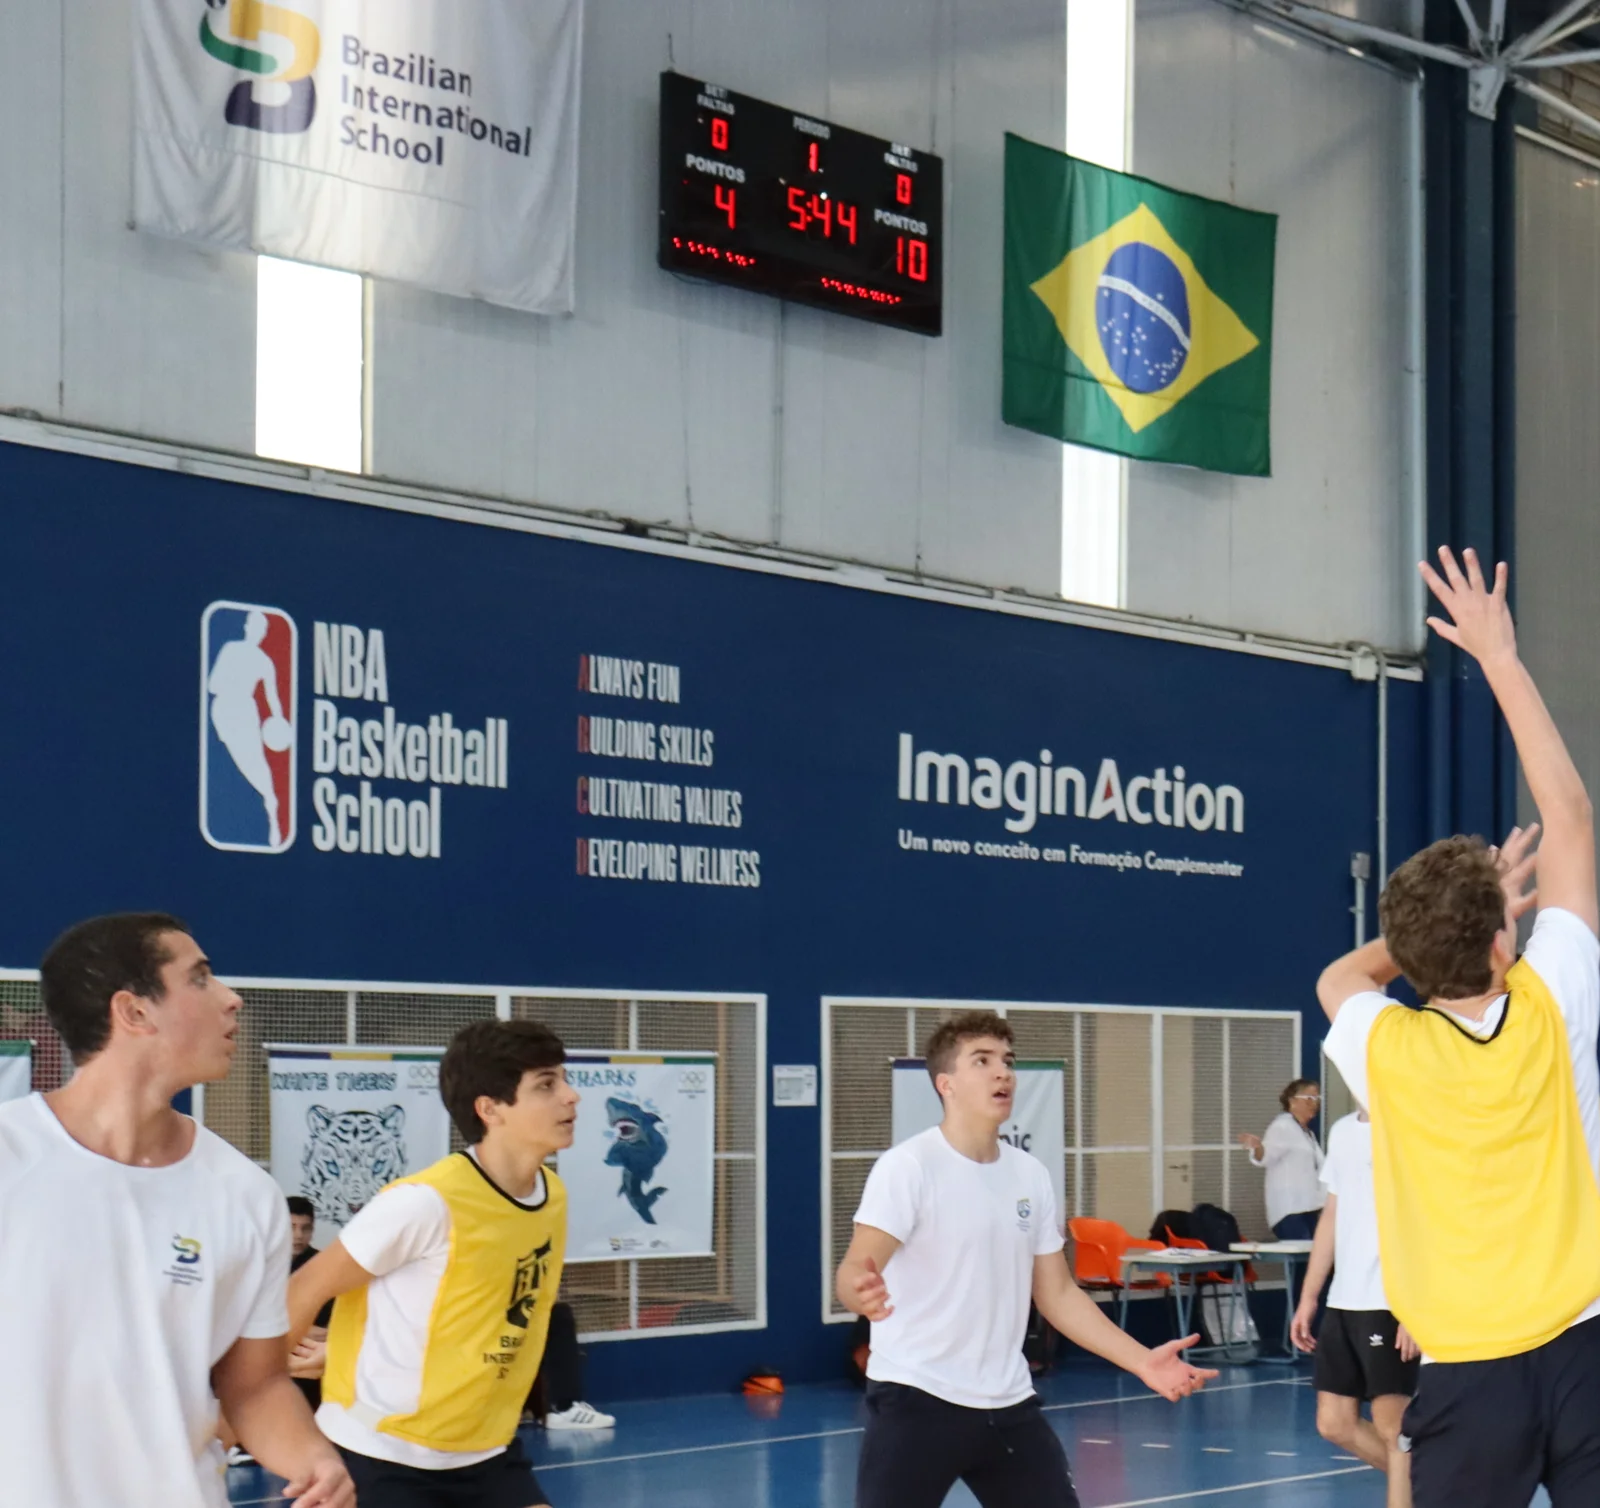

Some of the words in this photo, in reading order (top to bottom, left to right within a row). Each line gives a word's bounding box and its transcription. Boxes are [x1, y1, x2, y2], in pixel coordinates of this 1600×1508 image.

[342, 34, 472, 98] Brazilian
[340, 116, 444, 166] School
[342, 76, 532, 158] International
[711, 117, 729, 150] 0
[686, 153, 745, 183] PONTOS
[896, 173, 912, 205] 0
[714, 184, 736, 230] 4
[874, 208, 928, 236] PONTOS
[897, 236, 928, 282] 10
[313, 620, 389, 702] NBA
[578, 654, 644, 700] ALWAYS
[648, 661, 680, 704] FUN
[313, 699, 508, 789] Basketball
[578, 714, 655, 761] BUILDING
[659, 724, 714, 767] SKILLS
[577, 776, 681, 823] CULTIVATING
[684, 785, 742, 828] VALUES
[898, 732, 1244, 833] ImaginAction
[312, 777, 441, 858] School
[576, 837, 676, 882] DEVELOPING
[680, 845, 760, 888] WELLNESS
[898, 828, 928, 851] Um
[932, 838, 970, 855] novo
[974, 841, 1040, 861] conceito
[1042, 847, 1066, 863] em
[1069, 844, 1142, 872] Formação
[1144, 851, 1244, 876] Complementar
[271, 1072, 329, 1091] WHITE
[335, 1072, 398, 1091] TIGERS
